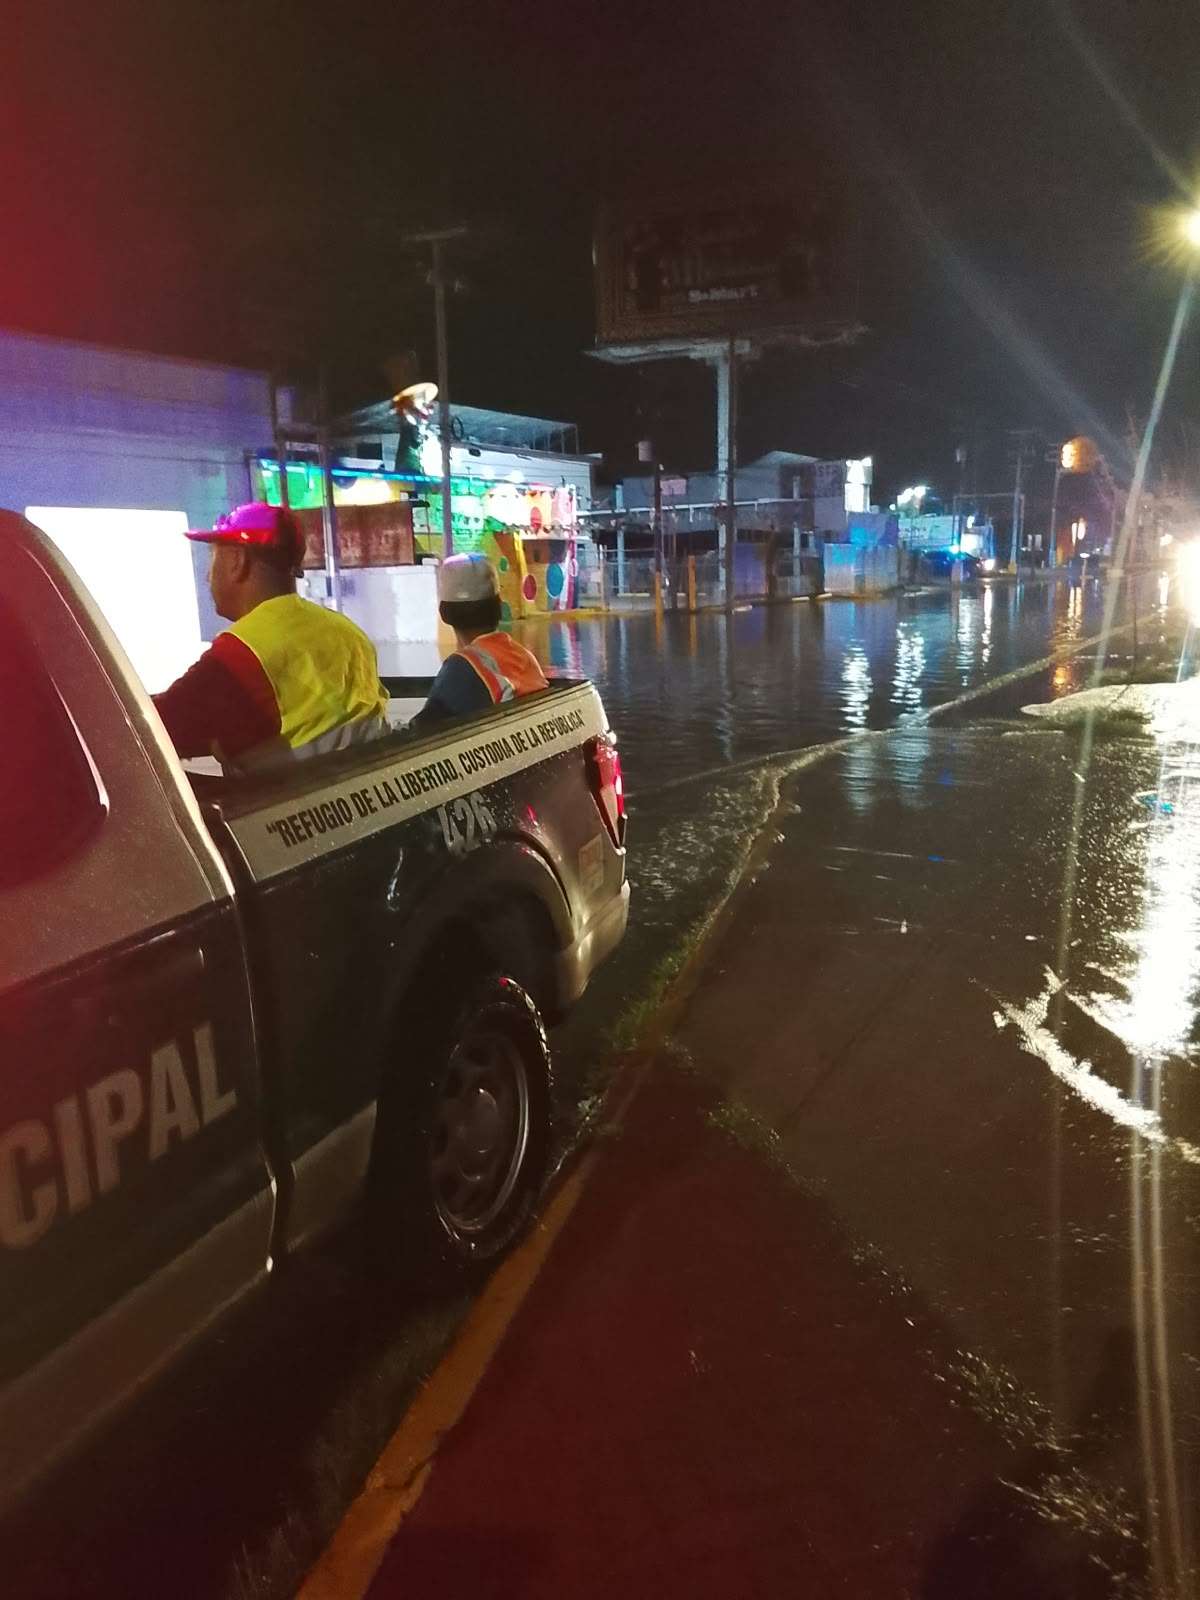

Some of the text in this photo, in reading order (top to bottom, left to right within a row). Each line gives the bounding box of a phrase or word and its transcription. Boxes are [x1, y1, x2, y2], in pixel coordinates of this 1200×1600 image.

[350, 788, 378, 818] DE
[373, 781, 400, 809] LA
[394, 758, 464, 801] LIBERTAD,
[458, 737, 515, 775] CUSTODIA
[510, 731, 529, 754] DE
[524, 727, 543, 748] LA
[0, 1021, 237, 1247] CIPAL
